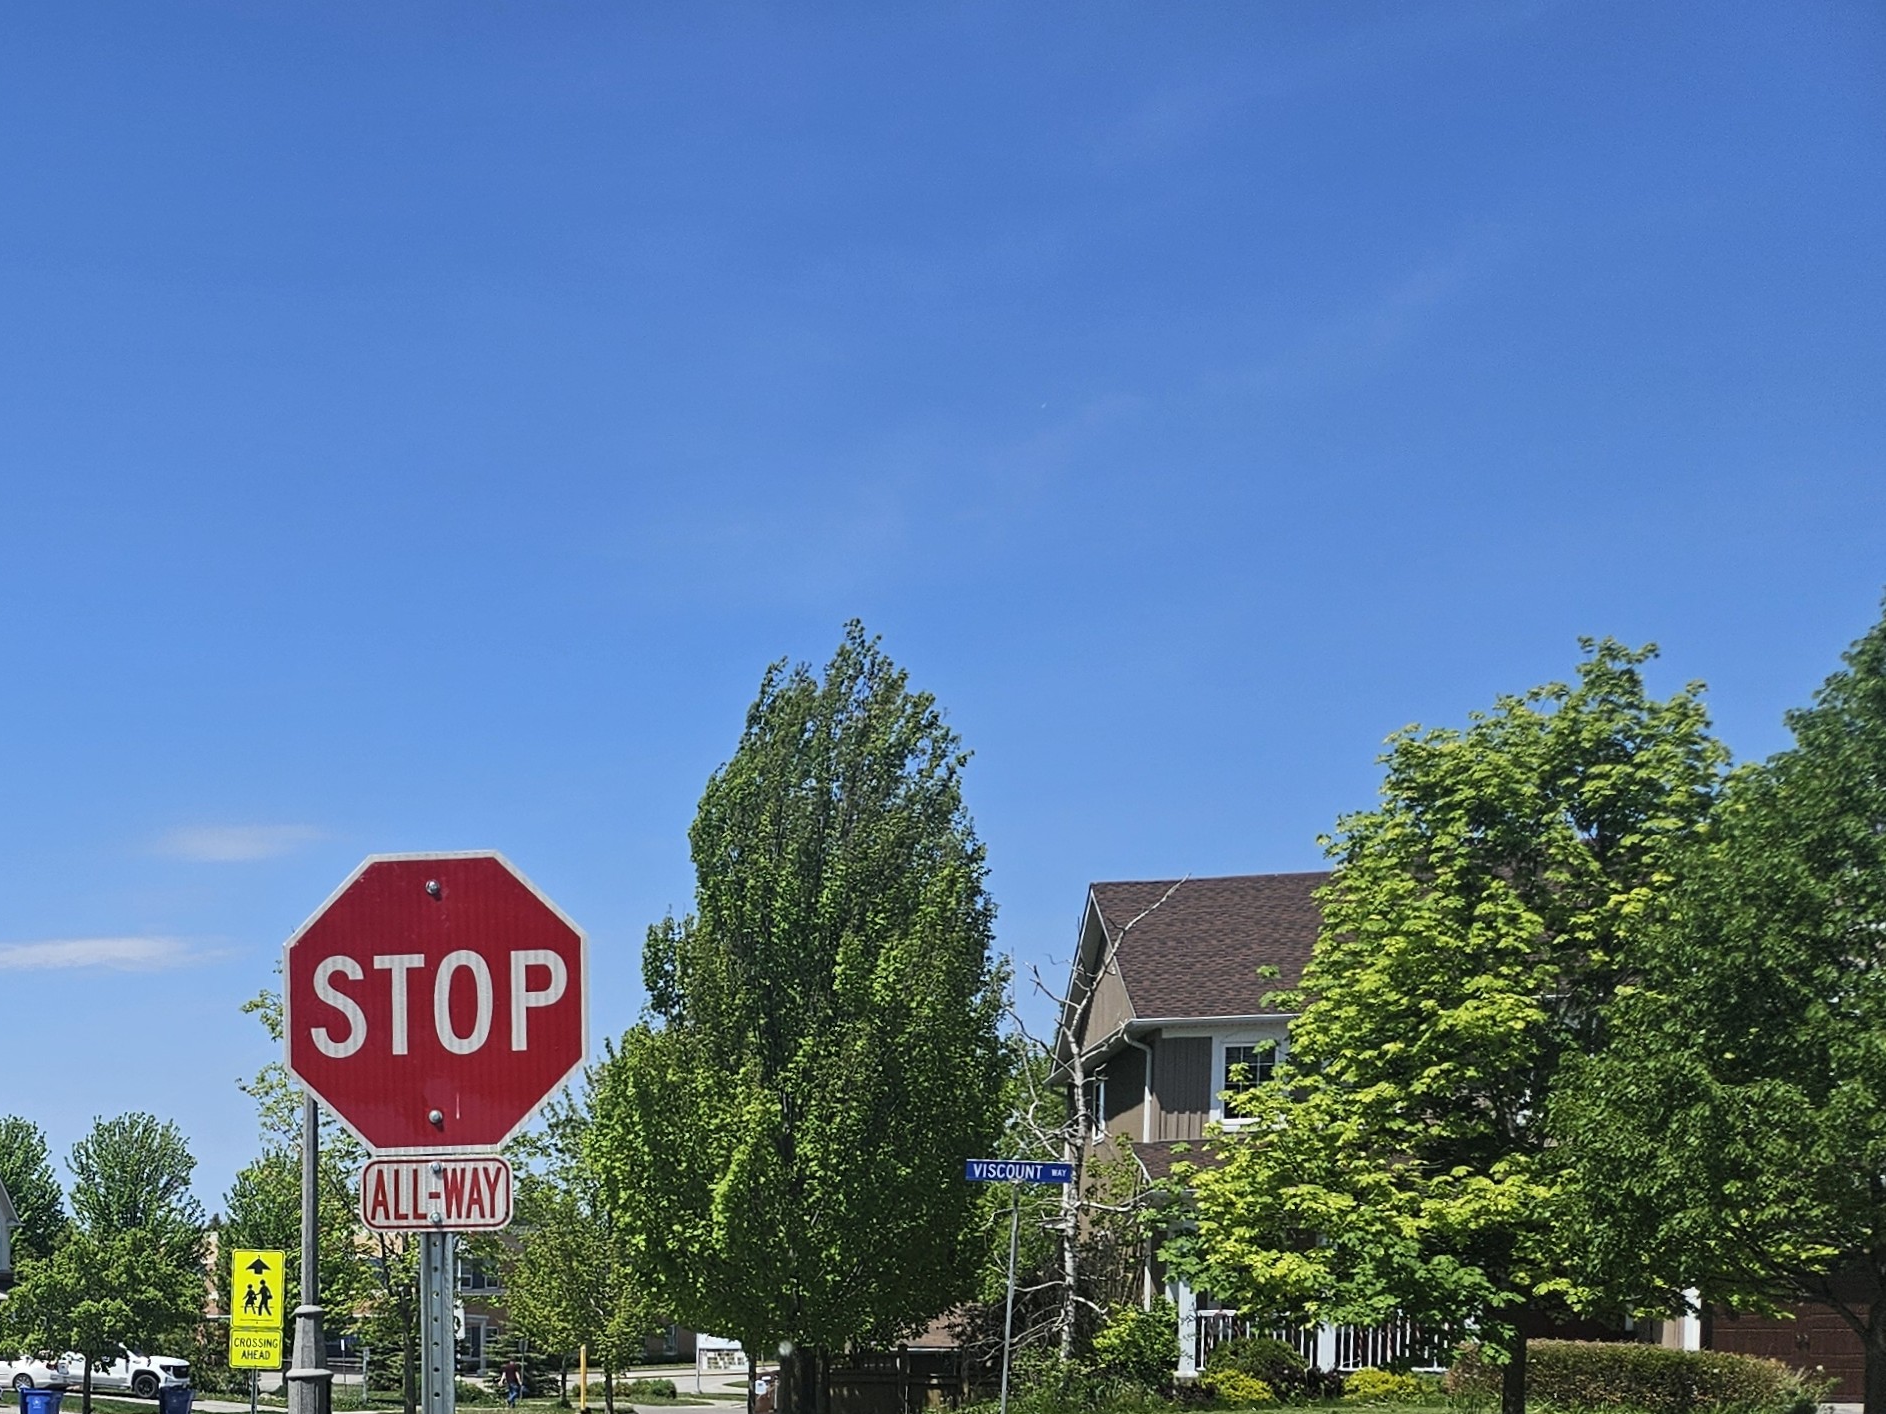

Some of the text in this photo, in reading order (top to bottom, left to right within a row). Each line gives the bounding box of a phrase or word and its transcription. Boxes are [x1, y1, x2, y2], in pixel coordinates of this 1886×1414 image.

[310, 949, 568, 1058] STOP
[973, 1163, 1067, 1180] VISCOUNT WAY
[370, 1165, 502, 1221] ALL-WAY
[234, 1337, 278, 1348] CROSSING
[241, 1349, 271, 1360] AHEAD
